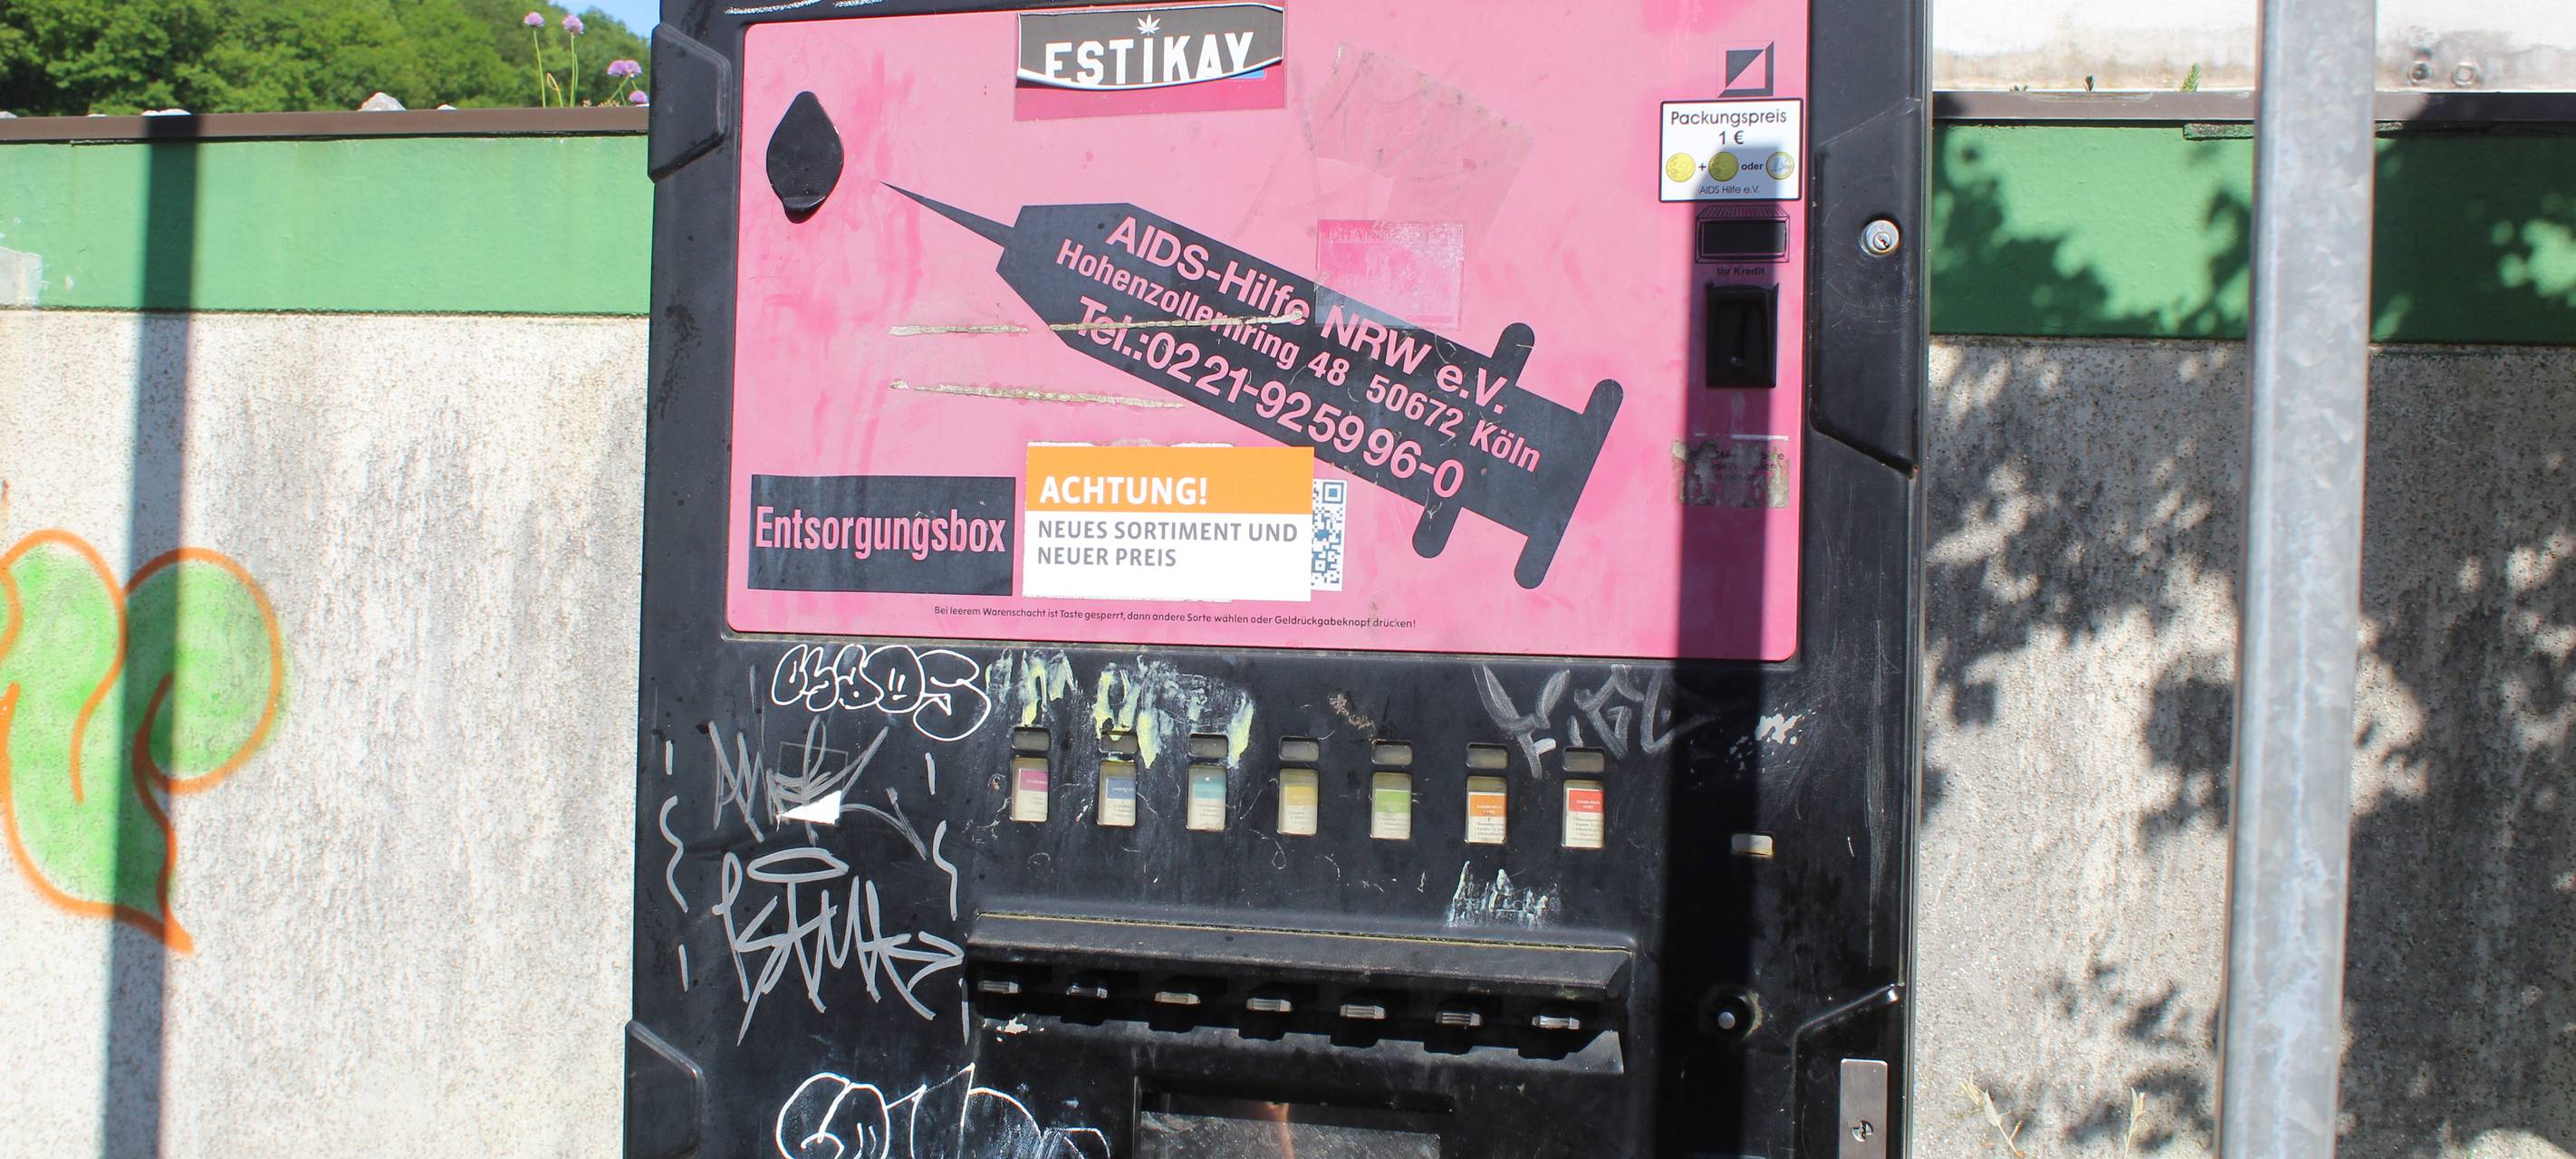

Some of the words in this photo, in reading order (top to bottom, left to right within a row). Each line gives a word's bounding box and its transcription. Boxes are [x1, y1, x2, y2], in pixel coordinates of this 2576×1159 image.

[1045, 32, 1254, 86] ESTIKAY
[1670, 109, 1787, 128] Packungspreis
[1718, 130, 1726, 146] 1
[1734, 129, 1745, 145] €
[1741, 162, 1764, 171] oder
[1699, 185, 1720, 195] AIDS
[1722, 185, 1742, 195] Hilfe
[1743, 186, 1760, 195] e.V.
[1716, 268, 1730, 276] Ihr
[1734, 268, 1764, 276] Kredit
[1105, 216, 1310, 326] AIDS-Hilfe
[1320, 304, 1432, 375] NRW
[1437, 364, 1507, 415] e.V.
[1056, 238, 1301, 369] Hohenzollernring
[1307, 350, 1350, 387] 48
[1365, 374, 1464, 438] 50672
[1469, 419, 1541, 473] Köln
[1039, 475, 1207, 505] ACHTUNG!
[755, 505, 1006, 561] Entsorgungsbox
[1038, 520, 1108, 540] NEUES
[1114, 522, 1242, 541] SORTIMENT
[1248, 523, 1298, 542] UND
[1037, 547, 1109, 566] NEUER
[1115, 548, 1177, 567] PREIS
[934, 606, 948, 615] Bei
[950, 607, 981, 617] leerem
[983, 608, 1045, 618] Warenschacht
[1047, 609, 1058, 618] ist
[1060, 609, 1083, 619] Taste
[1084, 611, 1125, 621] gesperrt,
[1127, 611, 1150, 621] dann
[1152, 612, 1186, 622] andere
[1187, 613, 1212, 623] Sorte
[1214, 614, 1249, 624] wählen
[1251, 615, 1272, 625] oder
[1274, 616, 1371, 627] Geldrückgabeknopf
[1372, 618, 1416, 628] drücken!
